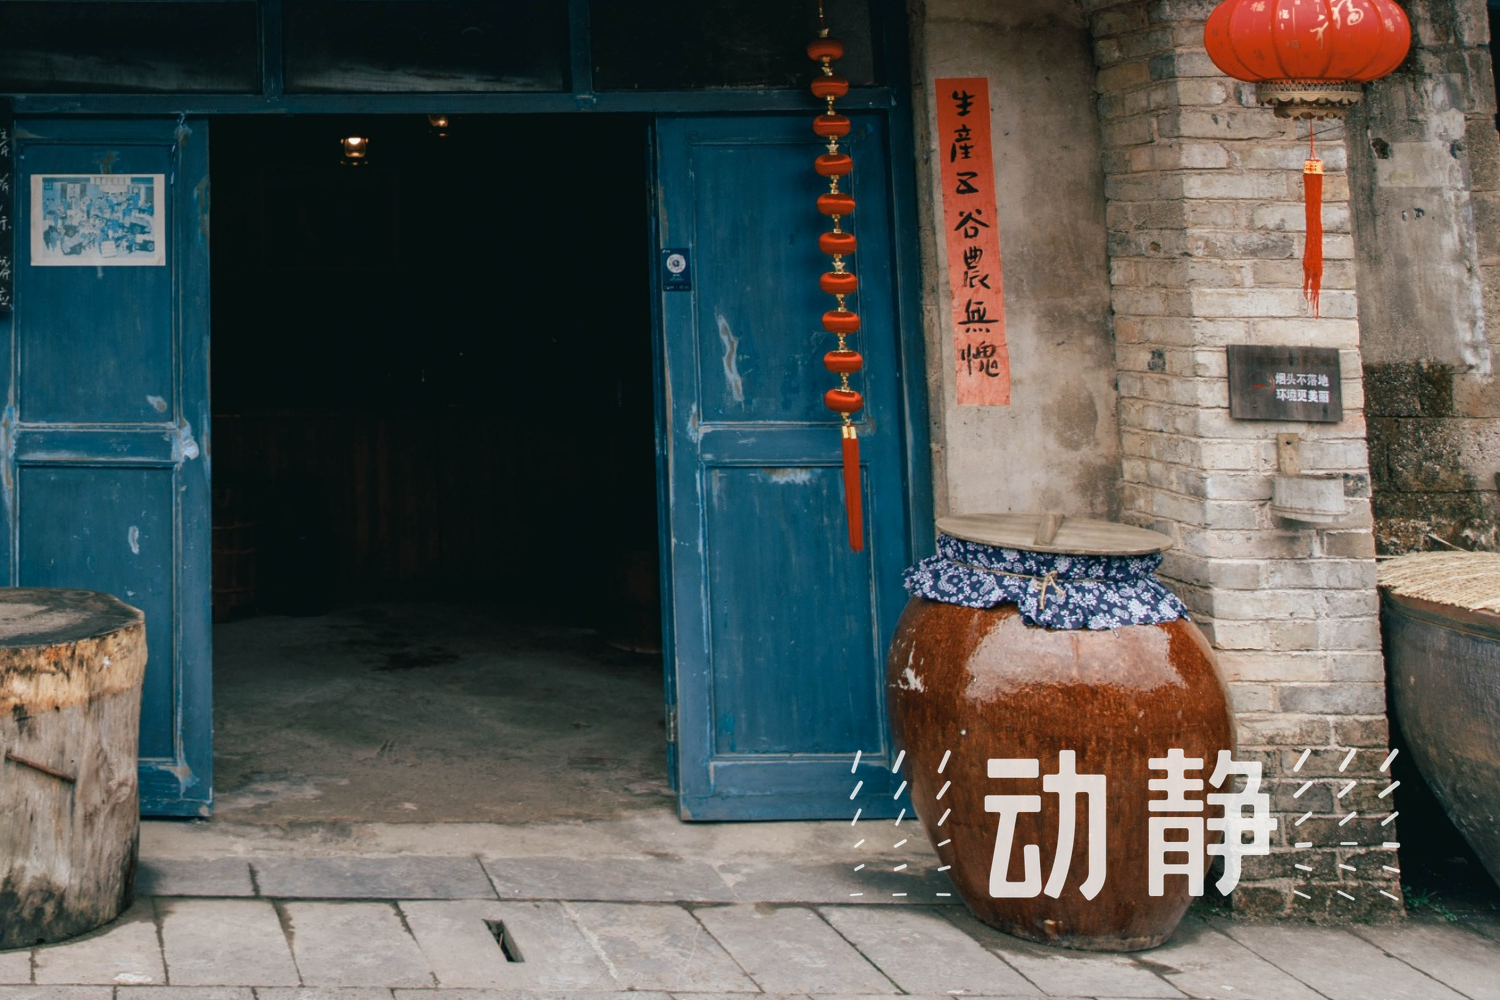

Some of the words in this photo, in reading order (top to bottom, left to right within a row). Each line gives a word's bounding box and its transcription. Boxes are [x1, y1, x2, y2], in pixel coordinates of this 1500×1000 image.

[1275, 372, 1330, 387] 烟头不落地
[1276, 388, 1330, 403] 环境更美丽
